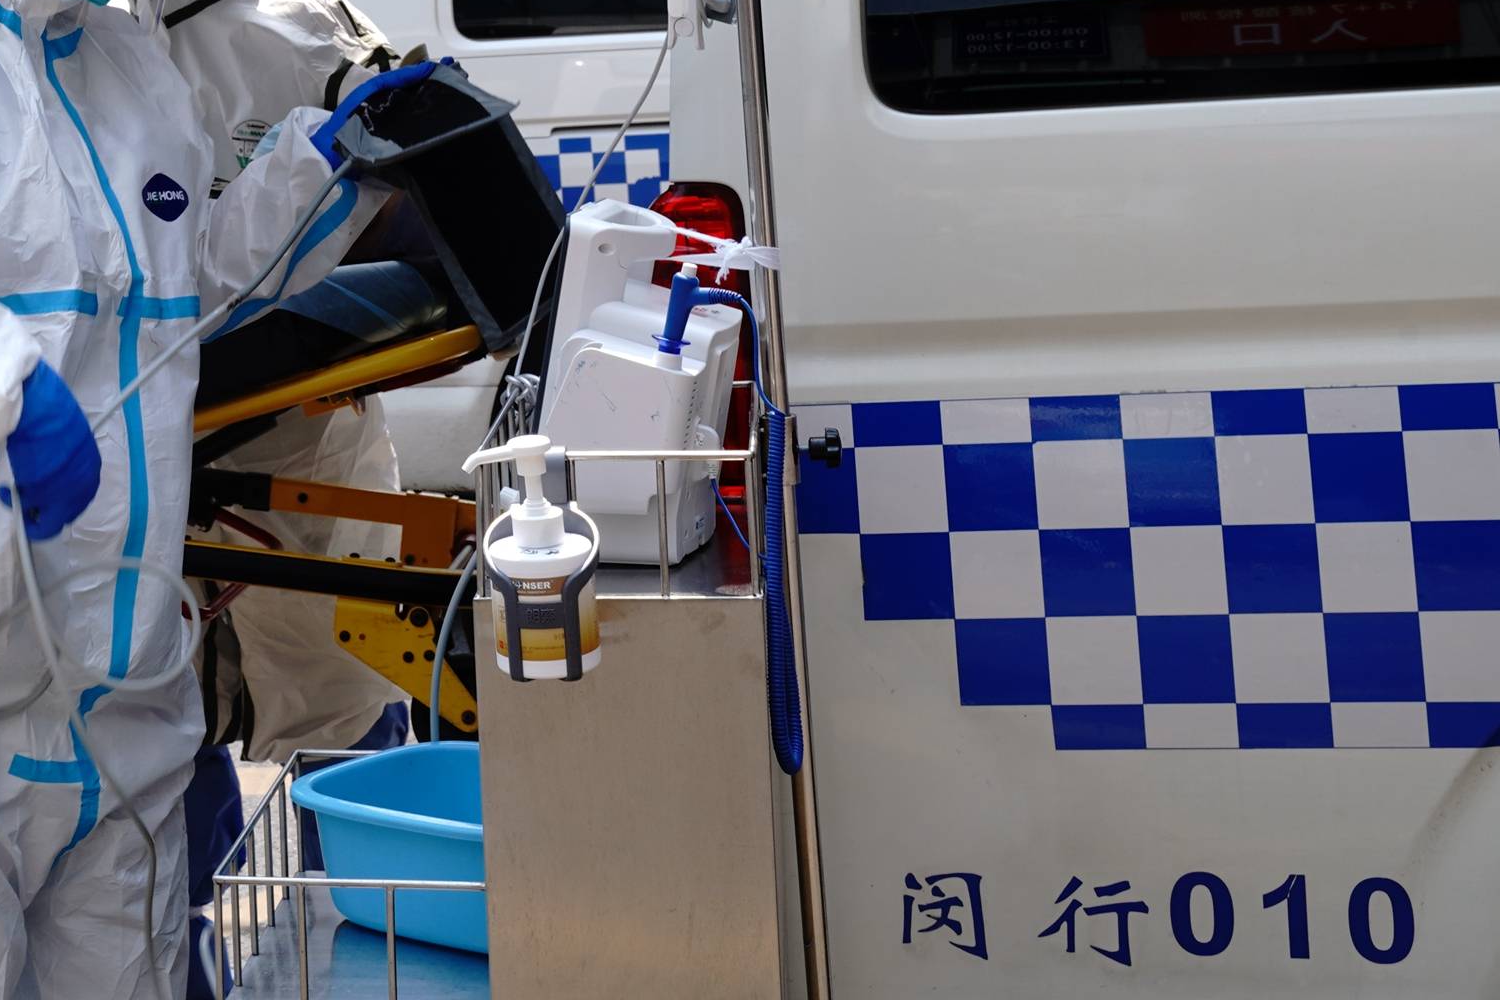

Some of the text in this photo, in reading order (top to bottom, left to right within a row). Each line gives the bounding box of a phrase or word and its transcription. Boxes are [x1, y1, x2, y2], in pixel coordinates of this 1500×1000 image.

[146, 190, 185, 201] JIE HONG
[512, 580, 552, 590] NSER
